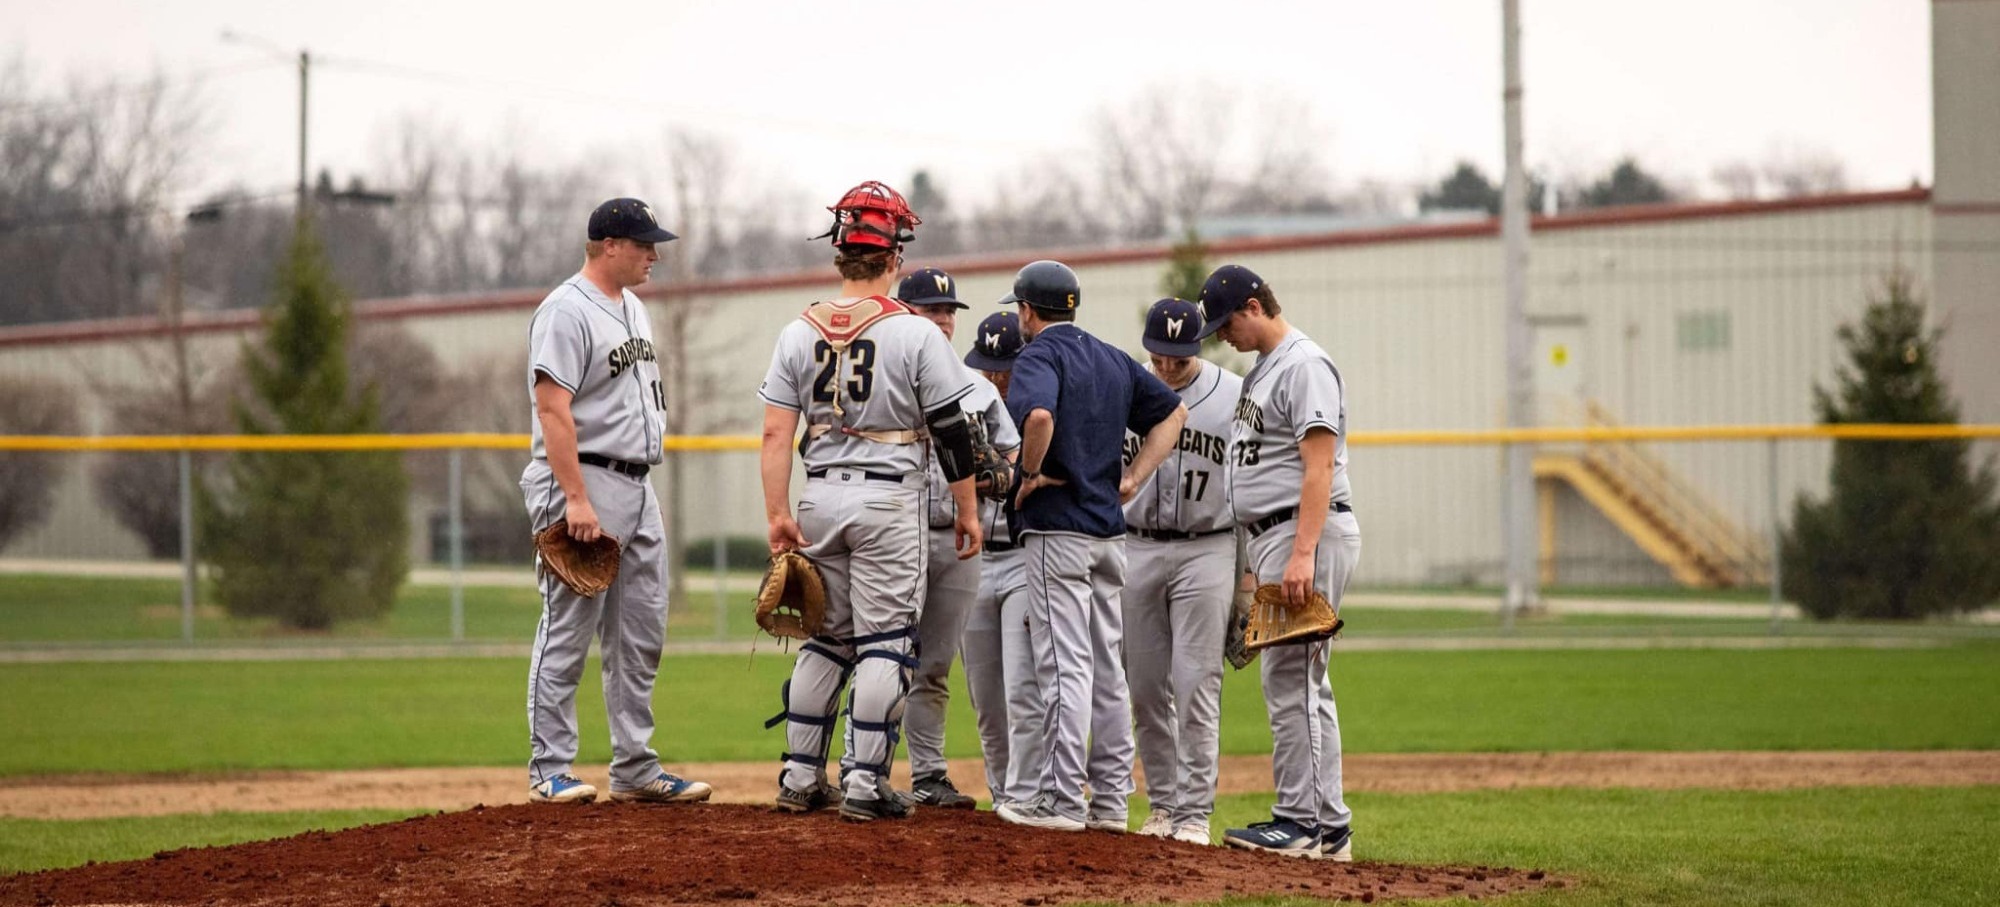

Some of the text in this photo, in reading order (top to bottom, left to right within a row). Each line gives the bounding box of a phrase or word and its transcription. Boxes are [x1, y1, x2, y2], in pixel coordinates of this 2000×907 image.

[933, 274, 949, 293] M
[1067, 294, 1075, 308] 5
[985, 332, 1001, 349] M
[1167, 317, 1184, 339] M
[812, 339, 876, 403] 23
[1121, 427, 1226, 467] SACATS
[1236, 439, 1262, 467] 13
[1183, 469, 1210, 502] 17
